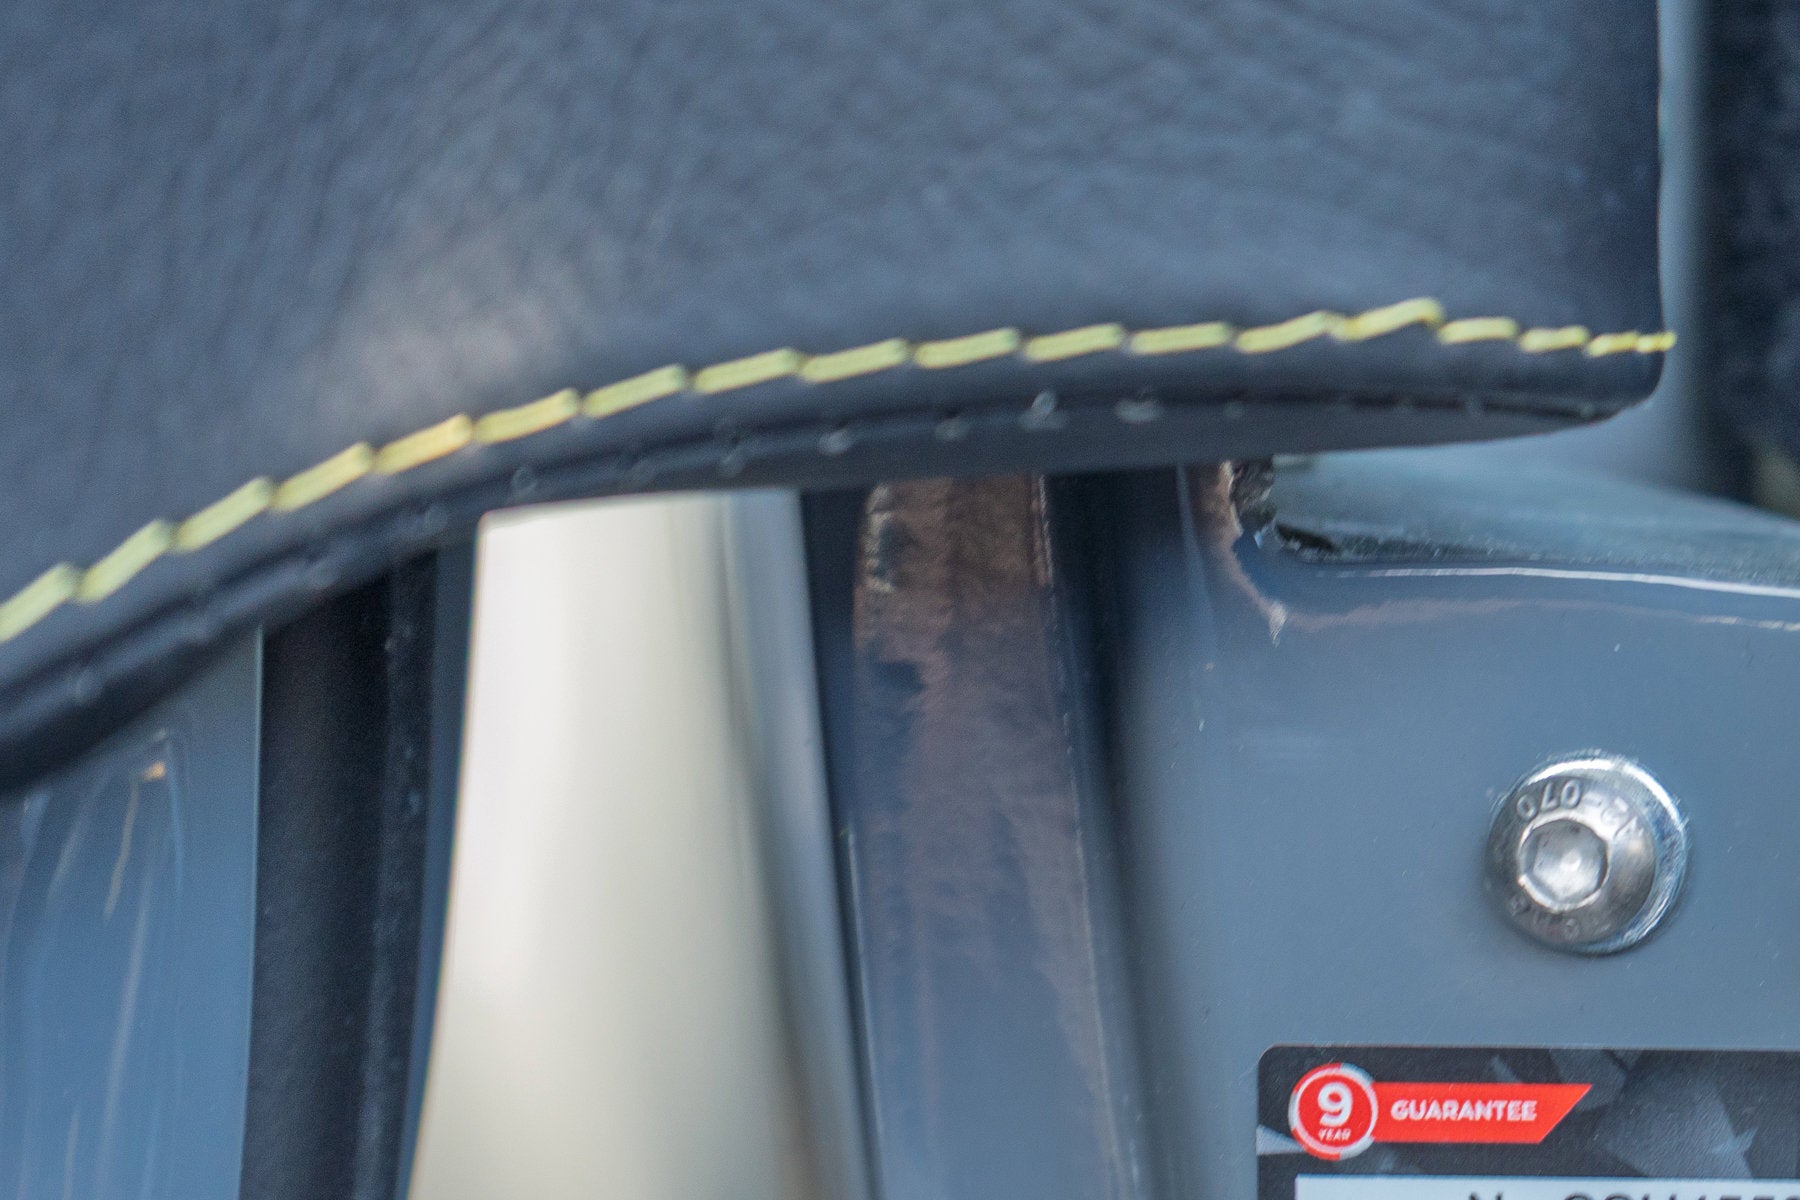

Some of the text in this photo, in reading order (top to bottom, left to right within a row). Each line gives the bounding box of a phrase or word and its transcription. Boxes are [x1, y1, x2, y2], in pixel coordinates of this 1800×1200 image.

[1317, 1081, 1353, 1127] 9
[1391, 1099, 1537, 1121] GUARANTEE
[1318, 1128, 1351, 1141] YEAR
